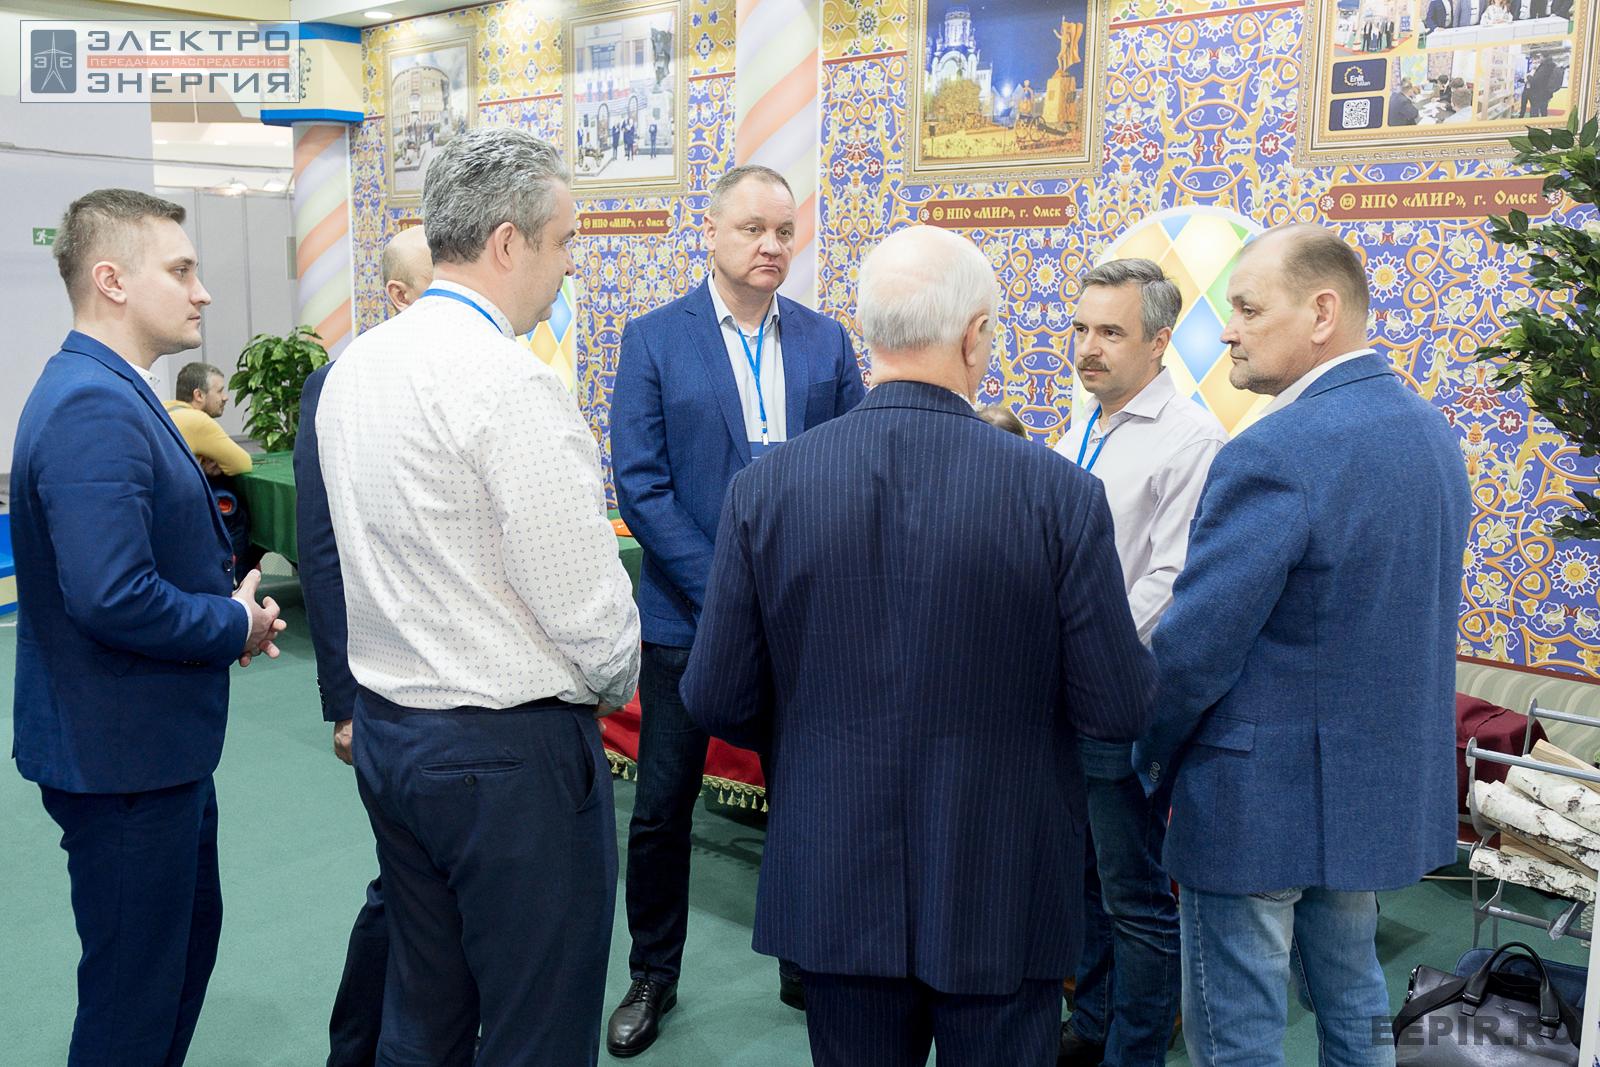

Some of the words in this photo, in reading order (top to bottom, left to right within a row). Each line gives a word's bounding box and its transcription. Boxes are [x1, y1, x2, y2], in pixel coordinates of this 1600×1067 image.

[1360, 193, 1398, 209] НПО
[1402, 191, 1466, 208] «МИР»,
[1473, 195, 1487, 205] г.
[1494, 189, 1538, 206] Омск
[946, 207, 971, 220] НПО
[1033, 205, 1062, 217] Омск
